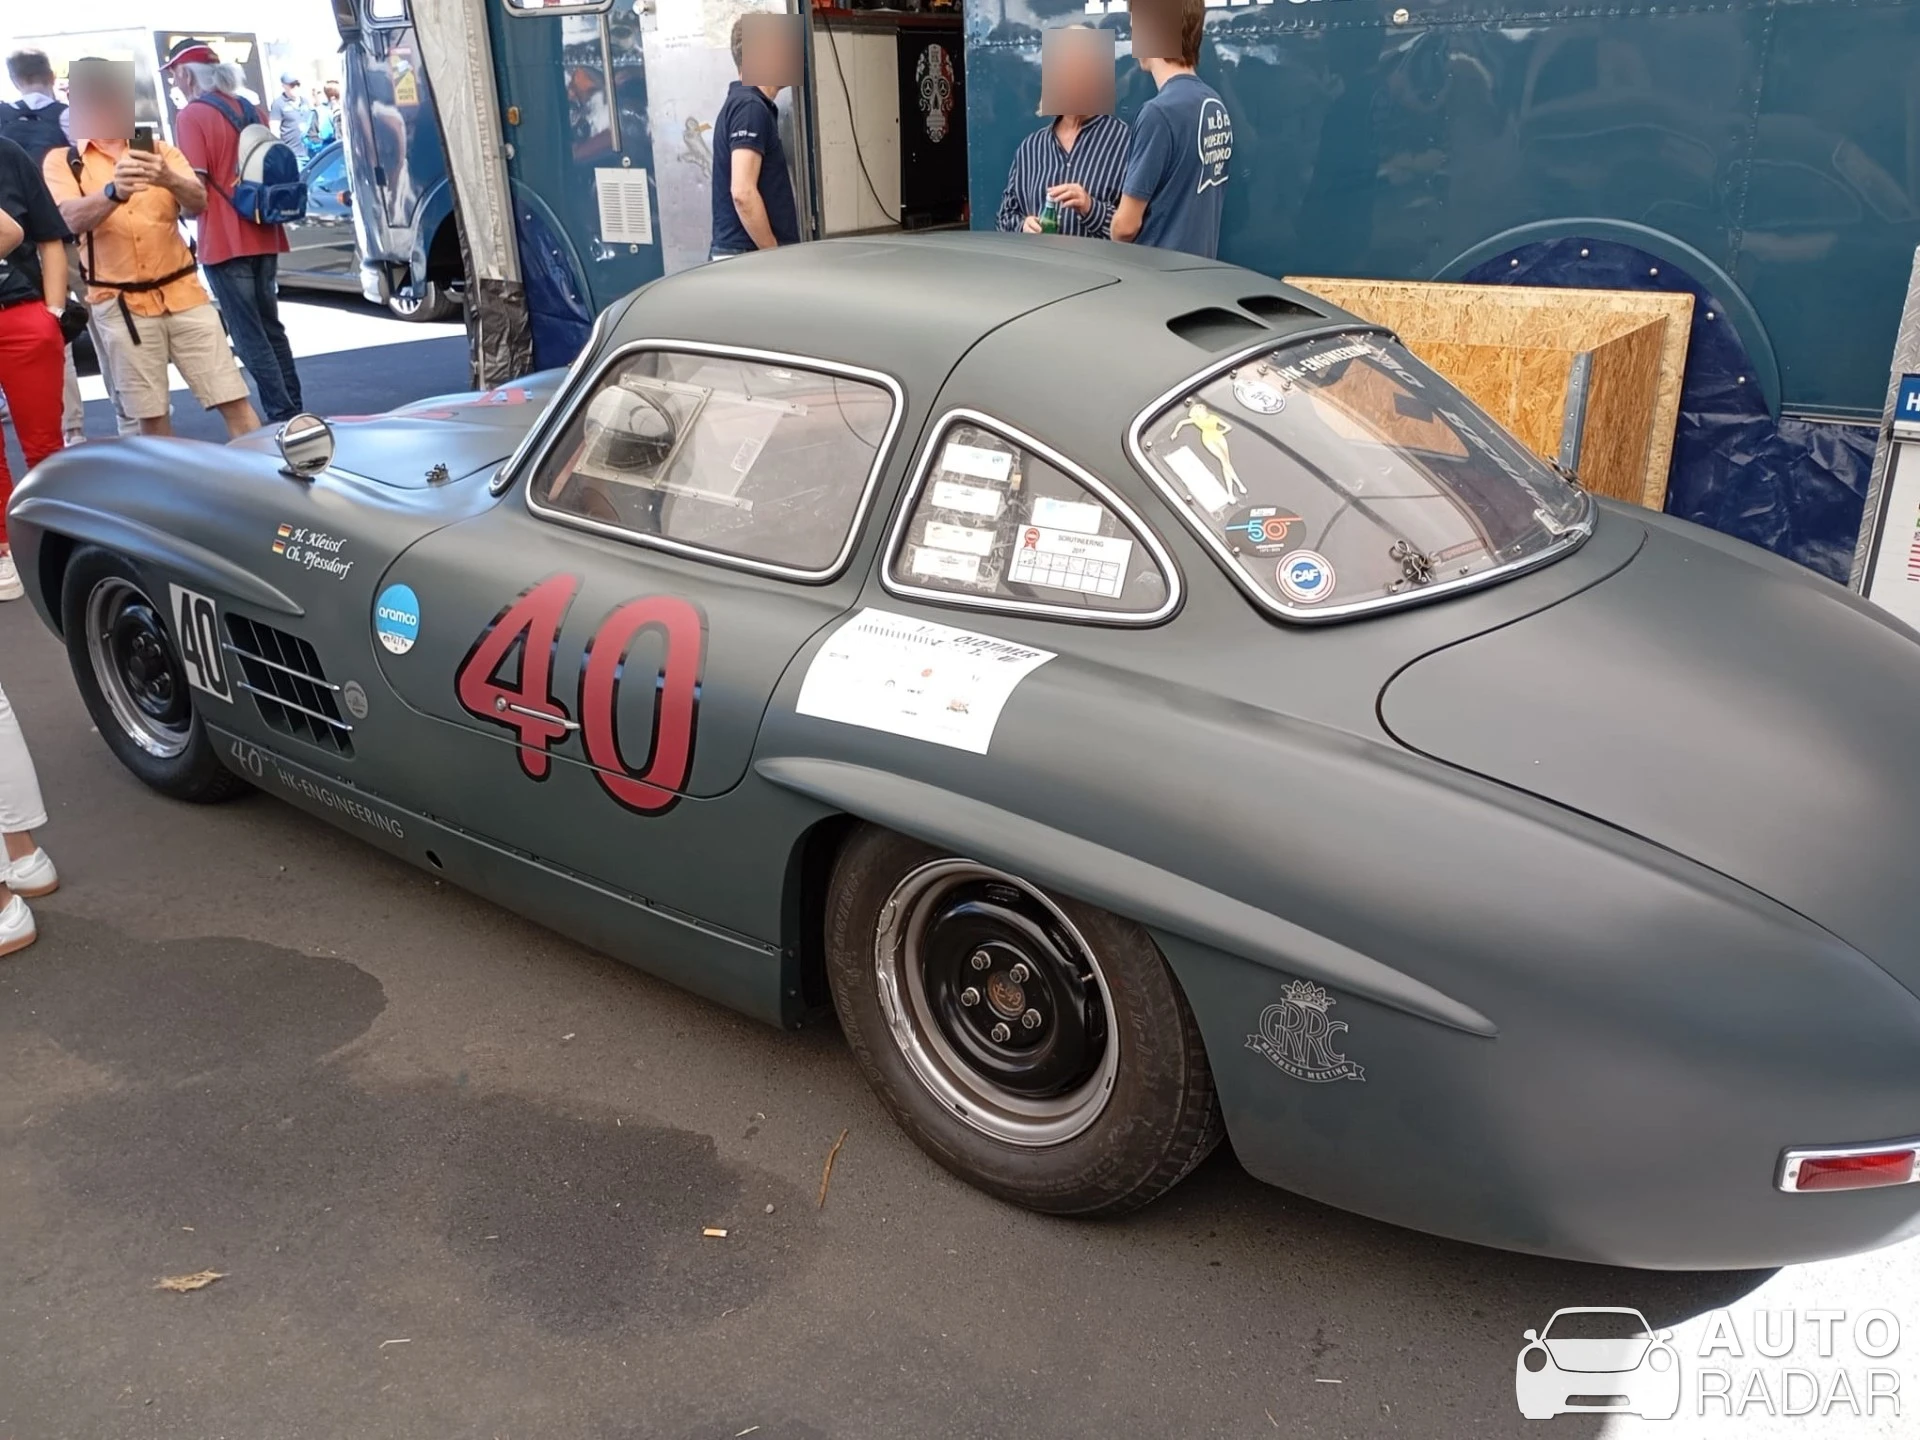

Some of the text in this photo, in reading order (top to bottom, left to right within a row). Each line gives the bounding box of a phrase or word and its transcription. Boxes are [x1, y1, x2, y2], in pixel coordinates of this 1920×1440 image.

[291, 528, 309, 543] H.
[1291, 568, 1319, 583] CAF
[378, 606, 418, 627] aramco
[181, 591, 229, 698] 40
[953, 636, 1041, 660] OLDTIMER
[454, 568, 710, 818] 40
[231, 740, 264, 778] 40
[277, 767, 405, 839] HK-ENGINEERING
[1259, 998, 1349, 1069] GRRC
[1261, 1041, 1350, 1080] MEMBERS MEETING
